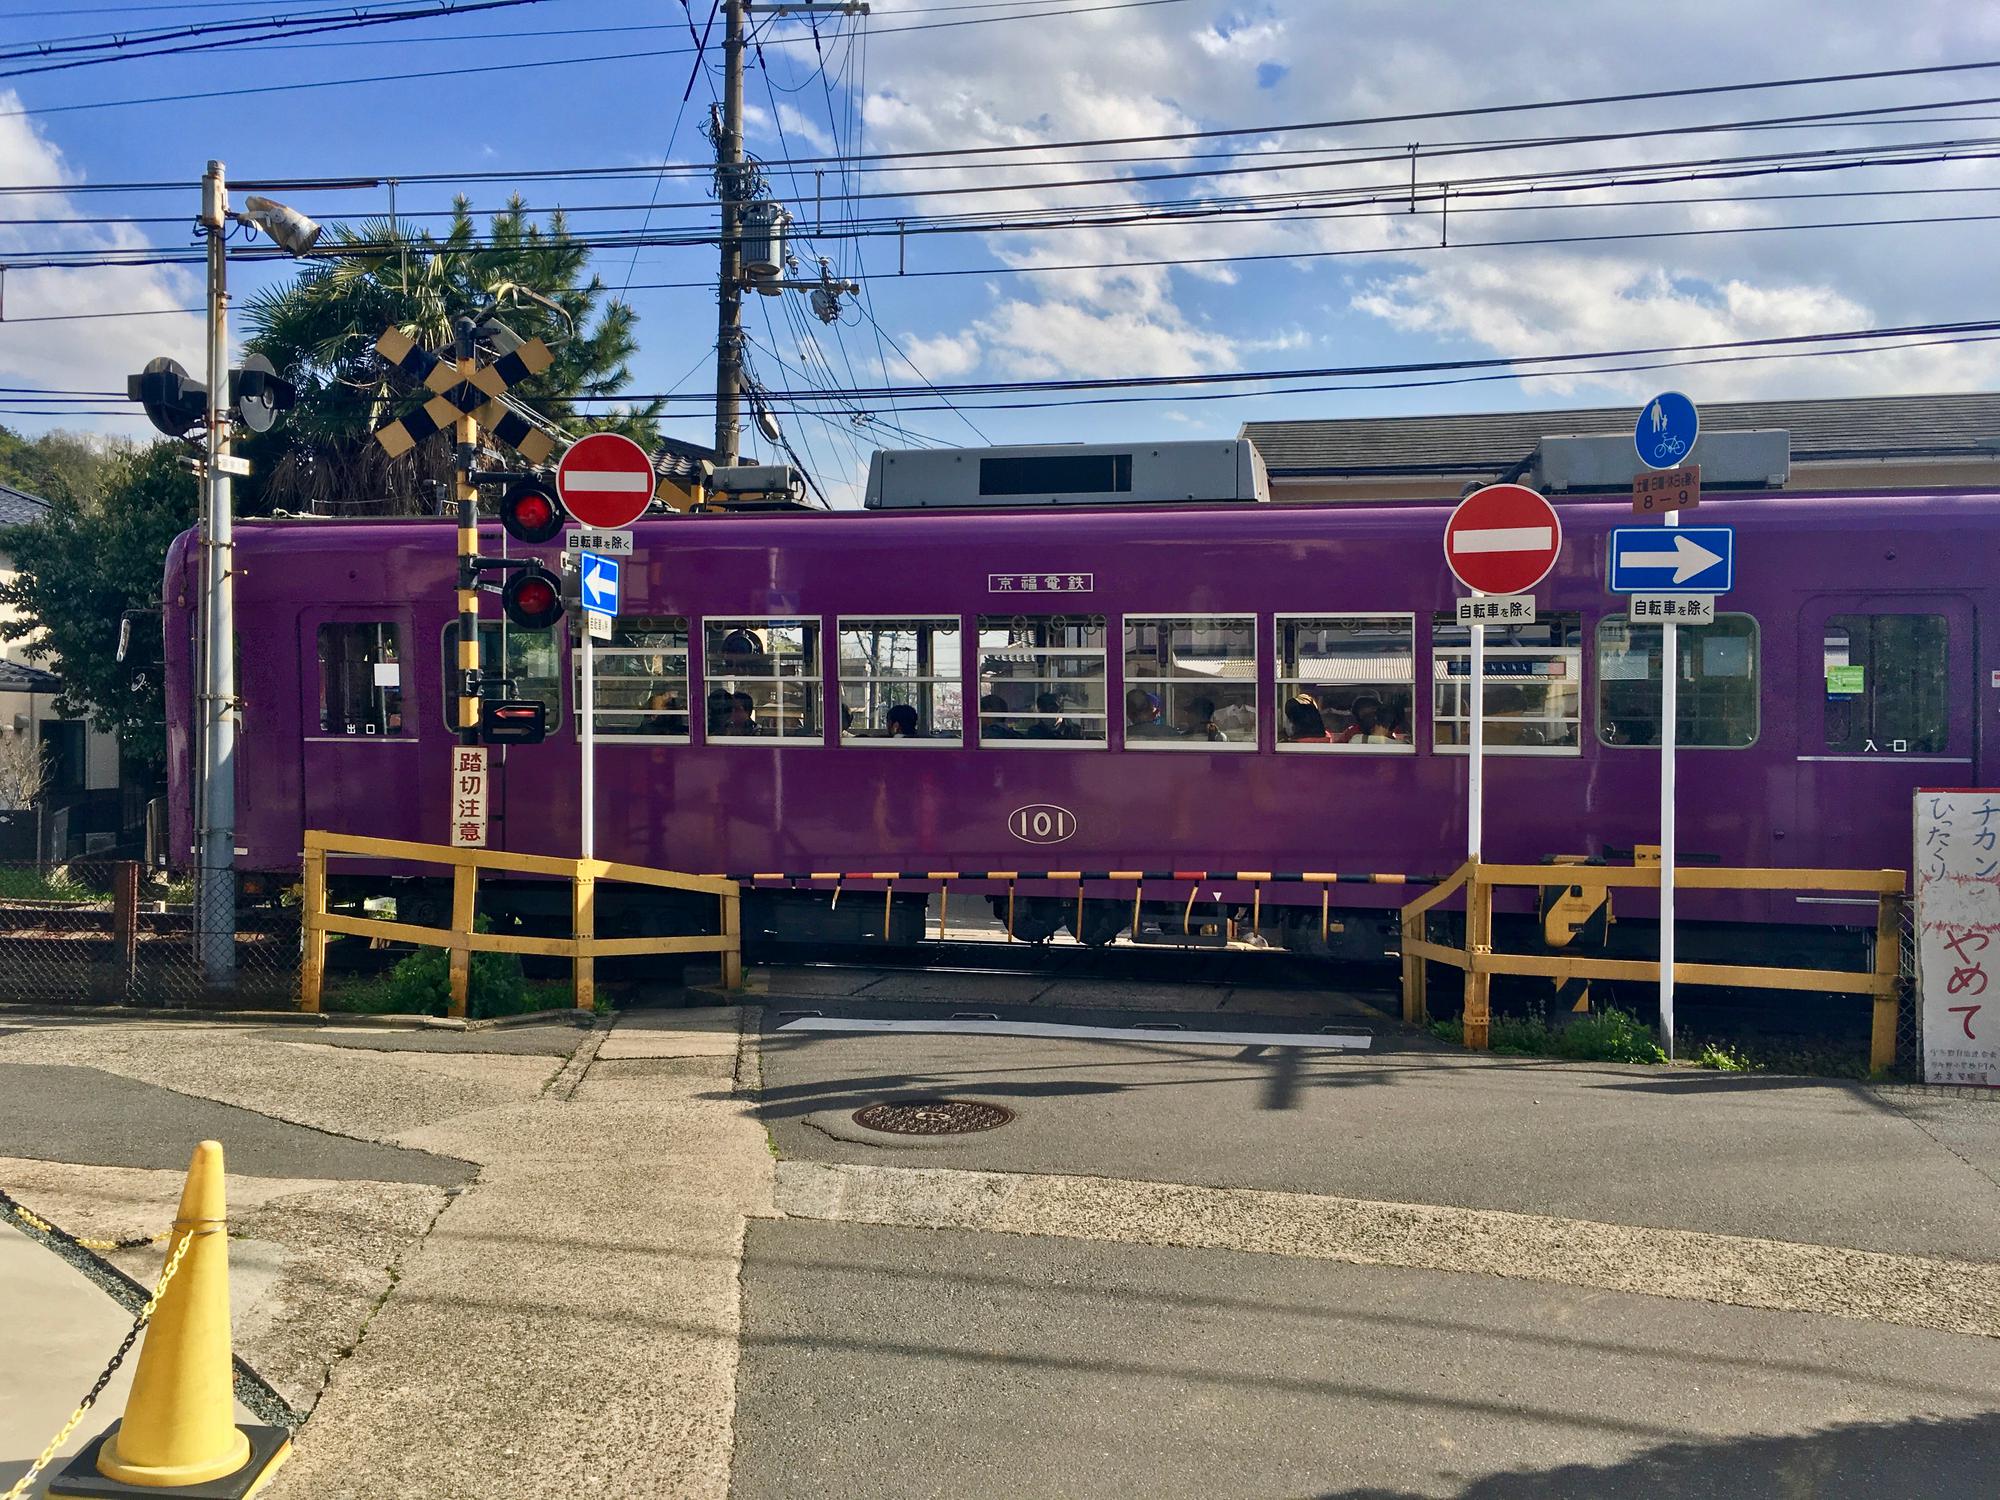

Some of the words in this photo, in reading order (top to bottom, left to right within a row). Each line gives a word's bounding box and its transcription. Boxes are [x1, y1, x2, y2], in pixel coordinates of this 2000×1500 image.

[569, 535, 630, 549] 自転車を除く
[997, 576, 1084, 590] 京福電鉄
[1460, 602, 1532, 618] 自転車を除く
[1634, 599, 1711, 616] 自転車を除く
[347, 724, 375, 734] 出口
[1864, 739, 1907, 752] 入口
[459, 752, 481, 842] 踏切注意
[1021, 811, 1063, 836] 101
[1926, 797, 1954, 882] ひったくり
[1972, 798, 2000, 877] チカン
[1943, 928, 1990, 1040] やめて
